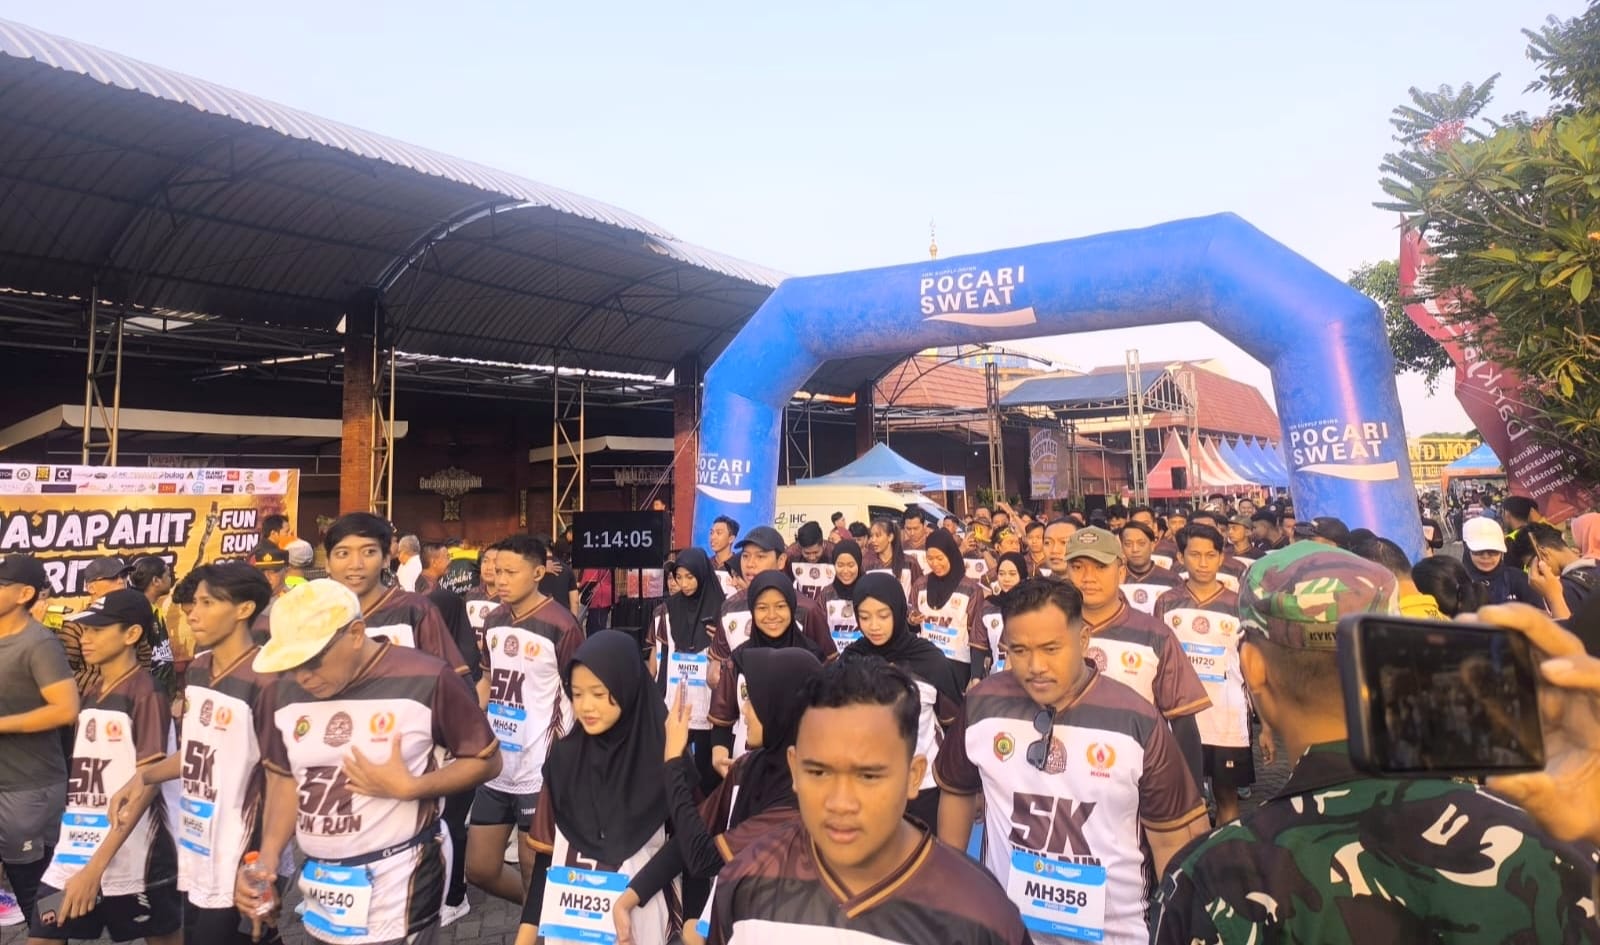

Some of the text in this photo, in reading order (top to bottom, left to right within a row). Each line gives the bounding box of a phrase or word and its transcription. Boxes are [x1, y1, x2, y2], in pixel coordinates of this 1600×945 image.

[920, 265, 1024, 296] POCARI
[921, 285, 1015, 314] SWEAT
[1290, 422, 1388, 448] POCARI
[1293, 440, 1382, 465] SWEAT
[697, 470, 744, 486] WEAT
[0, 512, 192, 549] AJAPAHIT
[221, 510, 257, 529] FUN
[790, 513, 807, 523] IHC
[222, 533, 259, 553] RUN
[583, 530, 653, 548] 1:14:05
[489, 668, 525, 703] 5K
[66, 757, 112, 794] 5K
[182, 739, 217, 787] 5K
[322, 814, 362, 834] RUN
[1008, 791, 1096, 856] 5K
[309, 887, 355, 908] MH540
[559, 891, 611, 912] MH233
[1024, 880, 1088, 907] MH358
